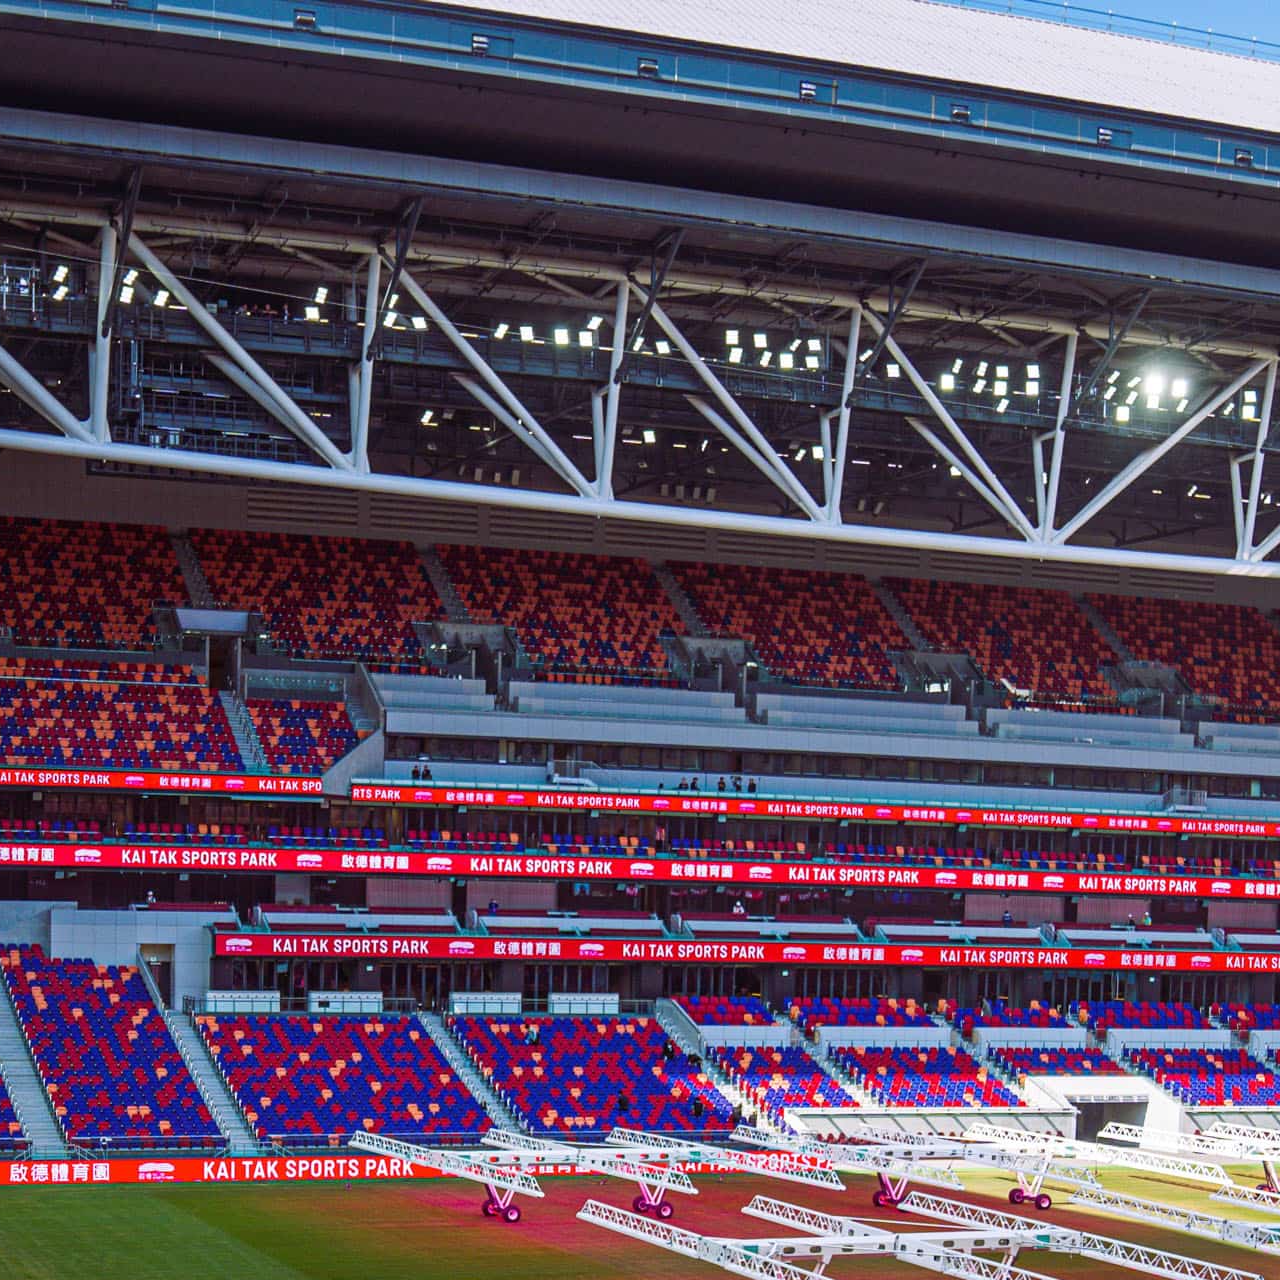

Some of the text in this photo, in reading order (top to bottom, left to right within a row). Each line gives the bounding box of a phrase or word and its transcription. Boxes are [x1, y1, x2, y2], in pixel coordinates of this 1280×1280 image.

[14, 771, 35, 783] TAK
[37, 771, 80, 784] SPORTS
[82, 773, 110, 785] PARK
[258, 779, 276, 790] KAI
[278, 779, 298, 791] TAK
[374, 788, 400, 800] PARK
[537, 794, 640, 808] KAI TAK SPORTS PARK
[767, 803, 863, 817] KAI TAK SPORTS PARK
[1181, 821, 1265, 833] KAI TAK SPORTS PARK
[121, 848, 277, 867] KAI TAK SPORTS PARK
[469, 857, 612, 875] KAI TAK SPORTS PARK
[788, 866, 919, 884] KAI TAK SPORTS PARK
[1078, 876, 1197, 893] KAI TAK SPORTS PARK
[272, 937, 429, 954] KAI TAK SPORTS PARK
[622, 942, 764, 959] KAI TAK SPORTS PARK
[939, 949, 1068, 965] KAI TAK SPORTS PARK
[1225, 955, 1245, 969] KAI
[1247, 955, 1268, 969] TAK
[203, 1157, 414, 1180] KAI TAK SPORTS PARK
